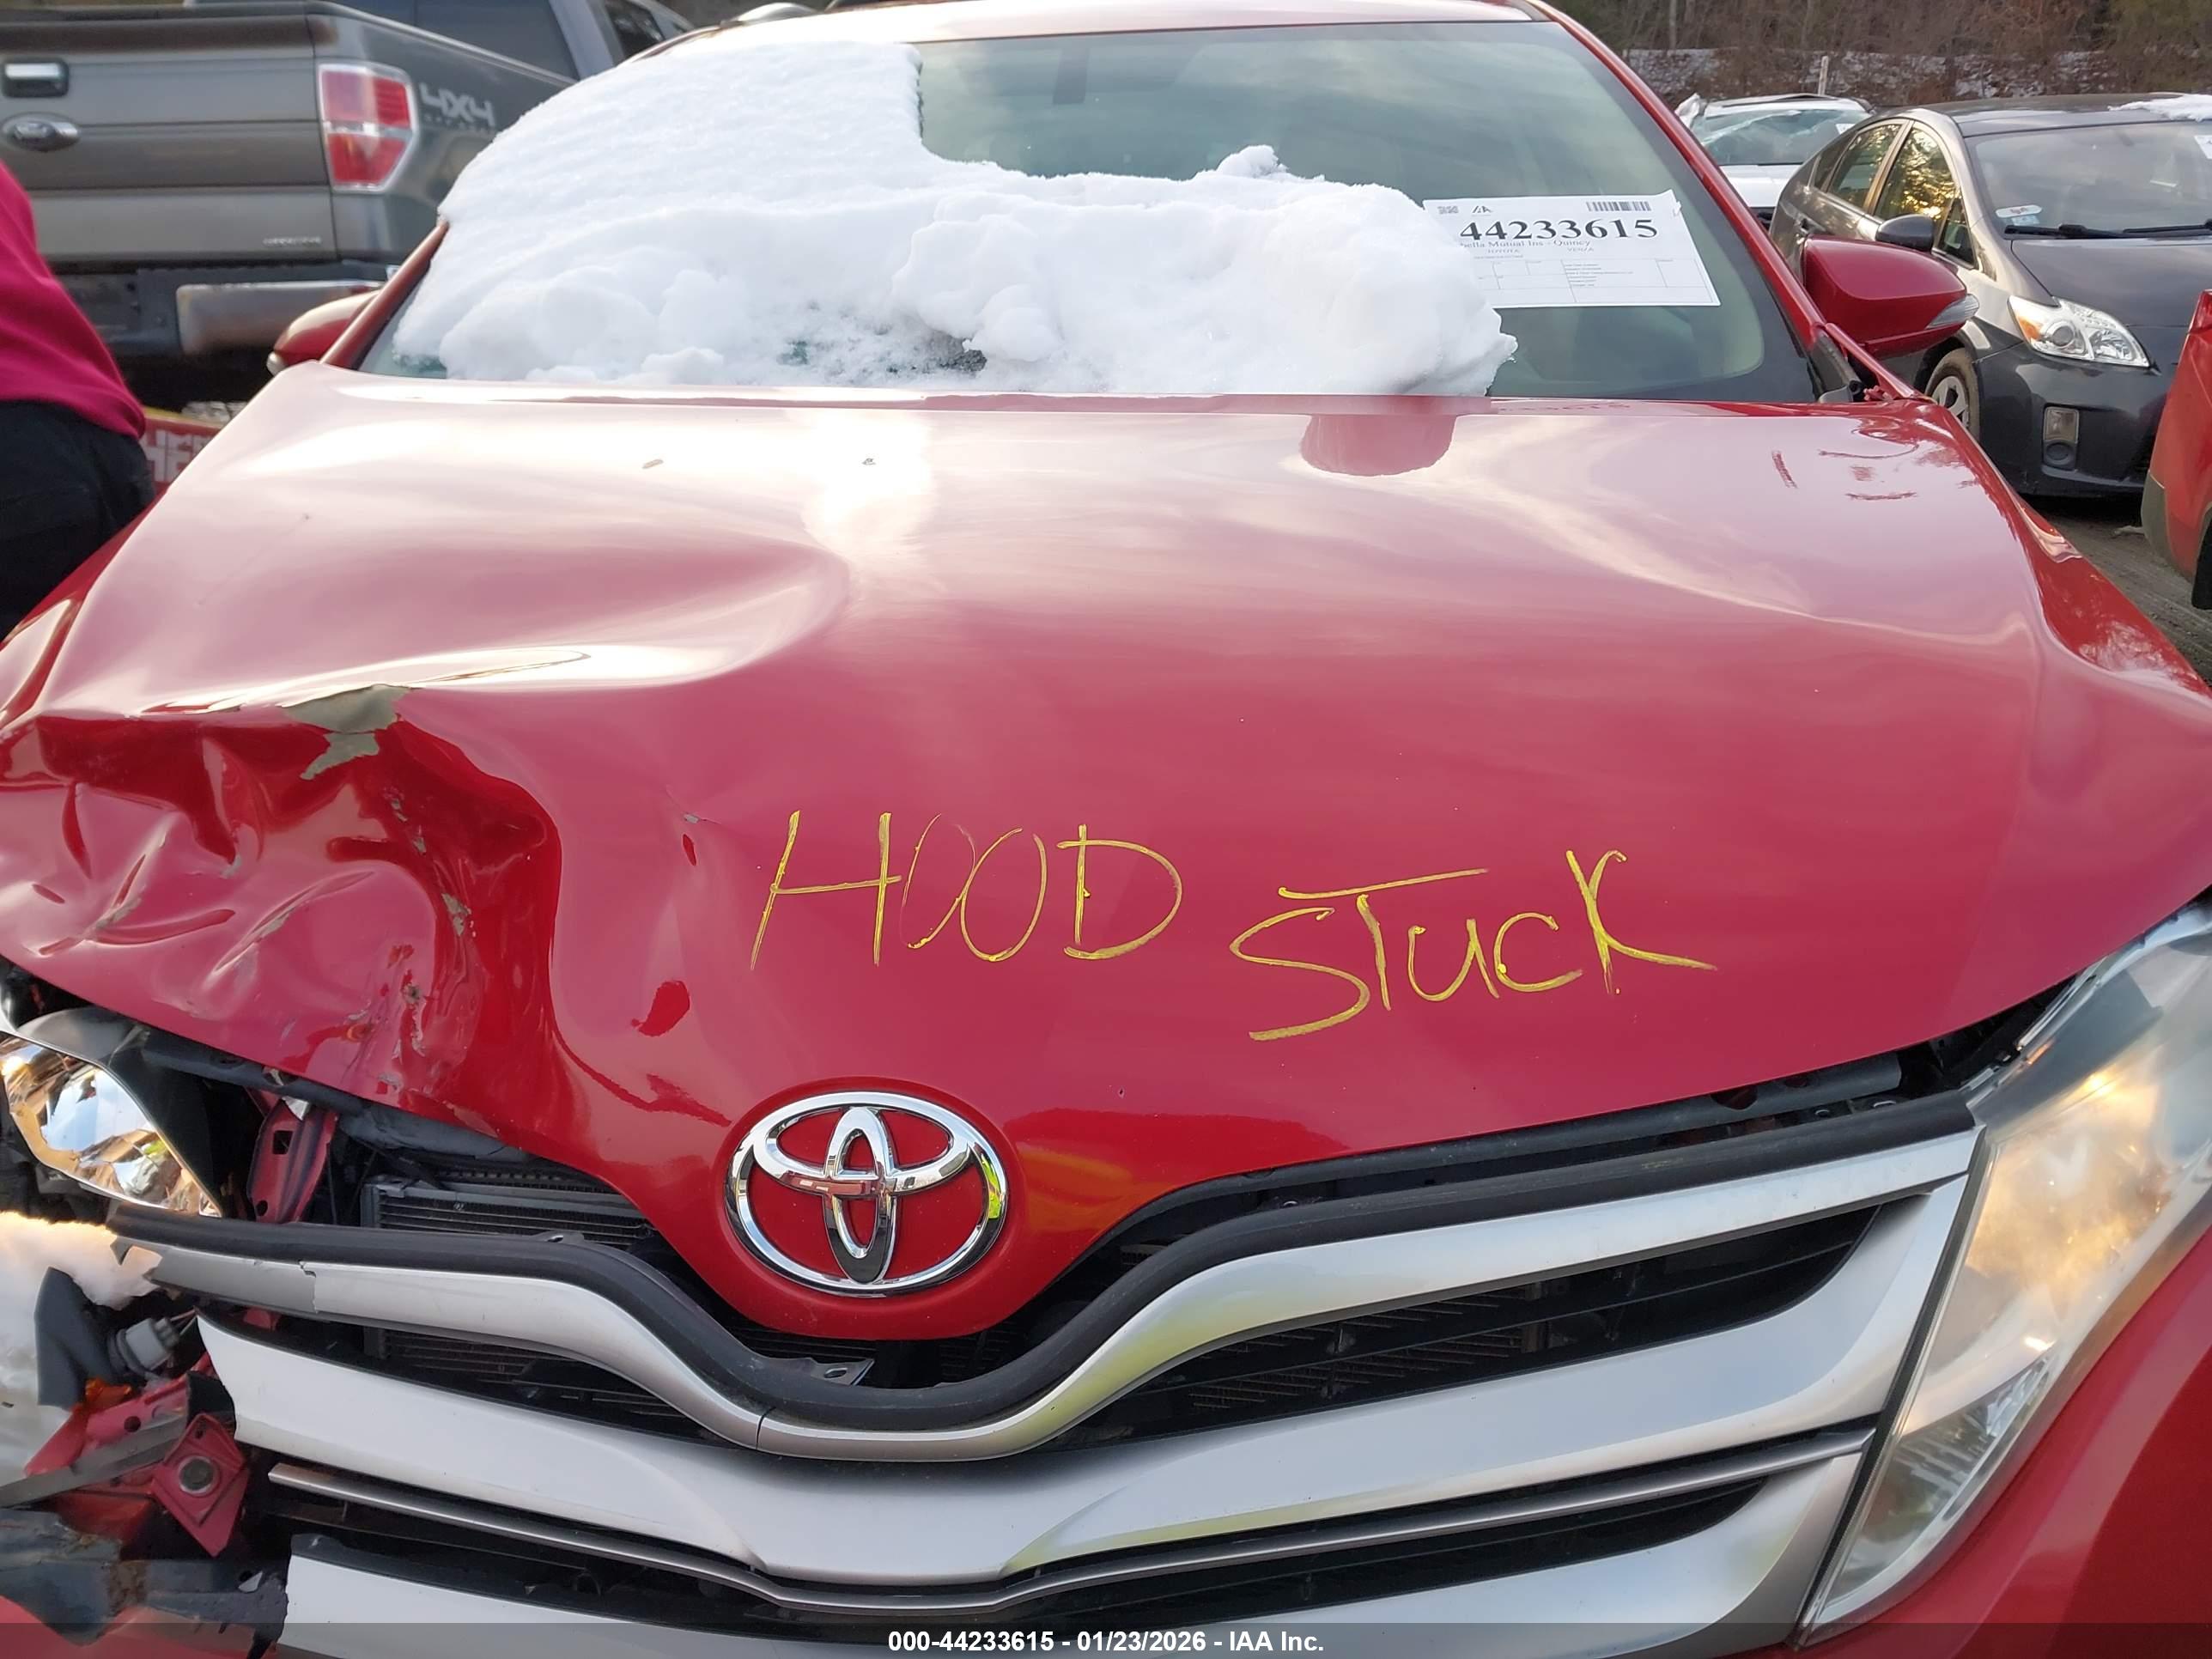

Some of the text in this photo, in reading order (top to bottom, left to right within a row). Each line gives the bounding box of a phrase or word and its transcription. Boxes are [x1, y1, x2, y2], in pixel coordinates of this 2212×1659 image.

[1460, 218, 1658, 240] 44233615
[1553, 239, 1591, 247] Quincy
[750, 810, 1183, 969] HOOD
